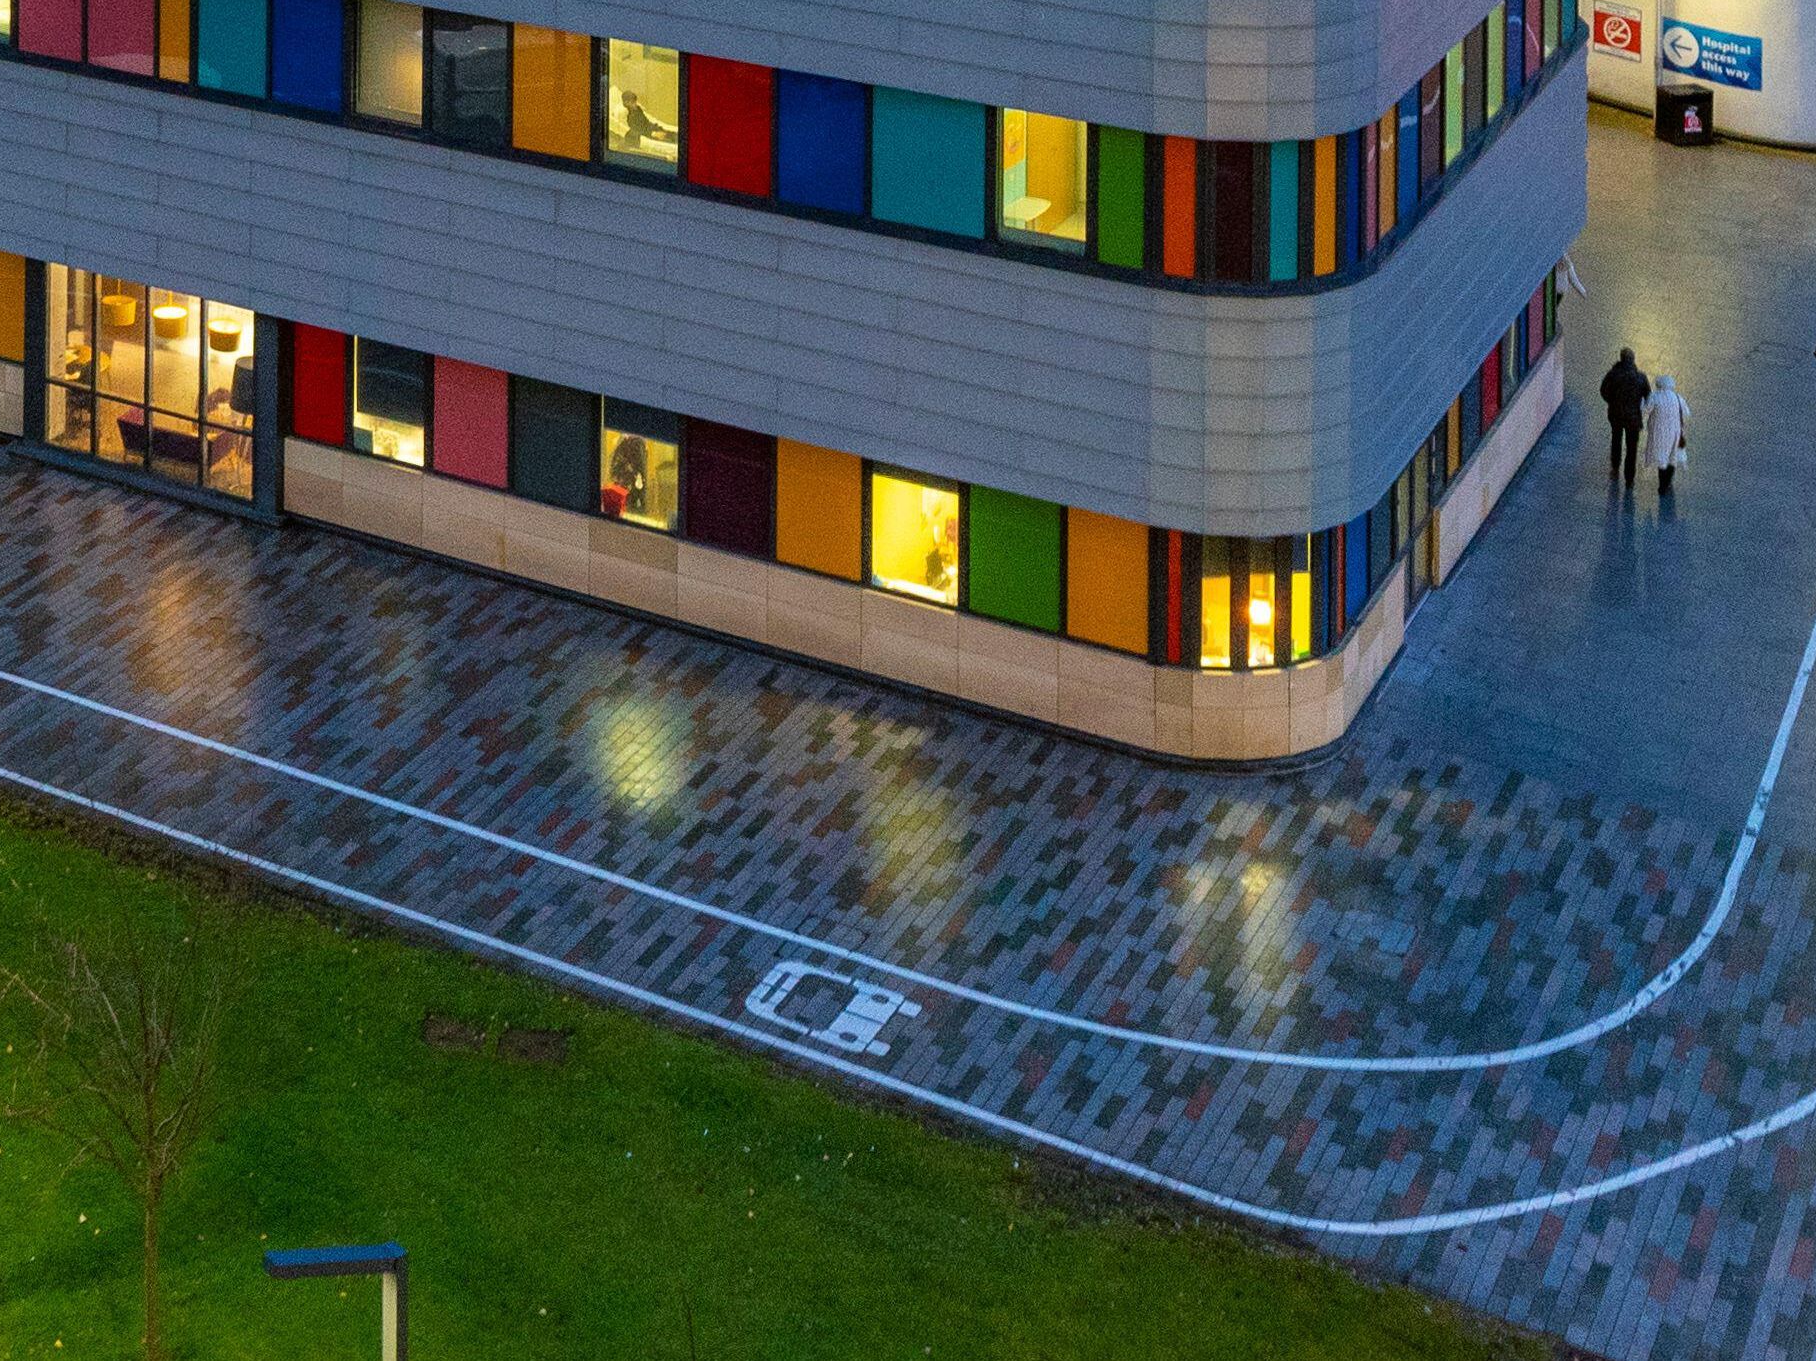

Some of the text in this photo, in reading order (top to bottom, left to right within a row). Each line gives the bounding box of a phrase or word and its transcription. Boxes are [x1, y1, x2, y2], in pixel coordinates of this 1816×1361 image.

[1701, 35, 1752, 56] Hospital
[1701, 50, 1738, 66] access
[1701, 60, 1751, 82] this way
